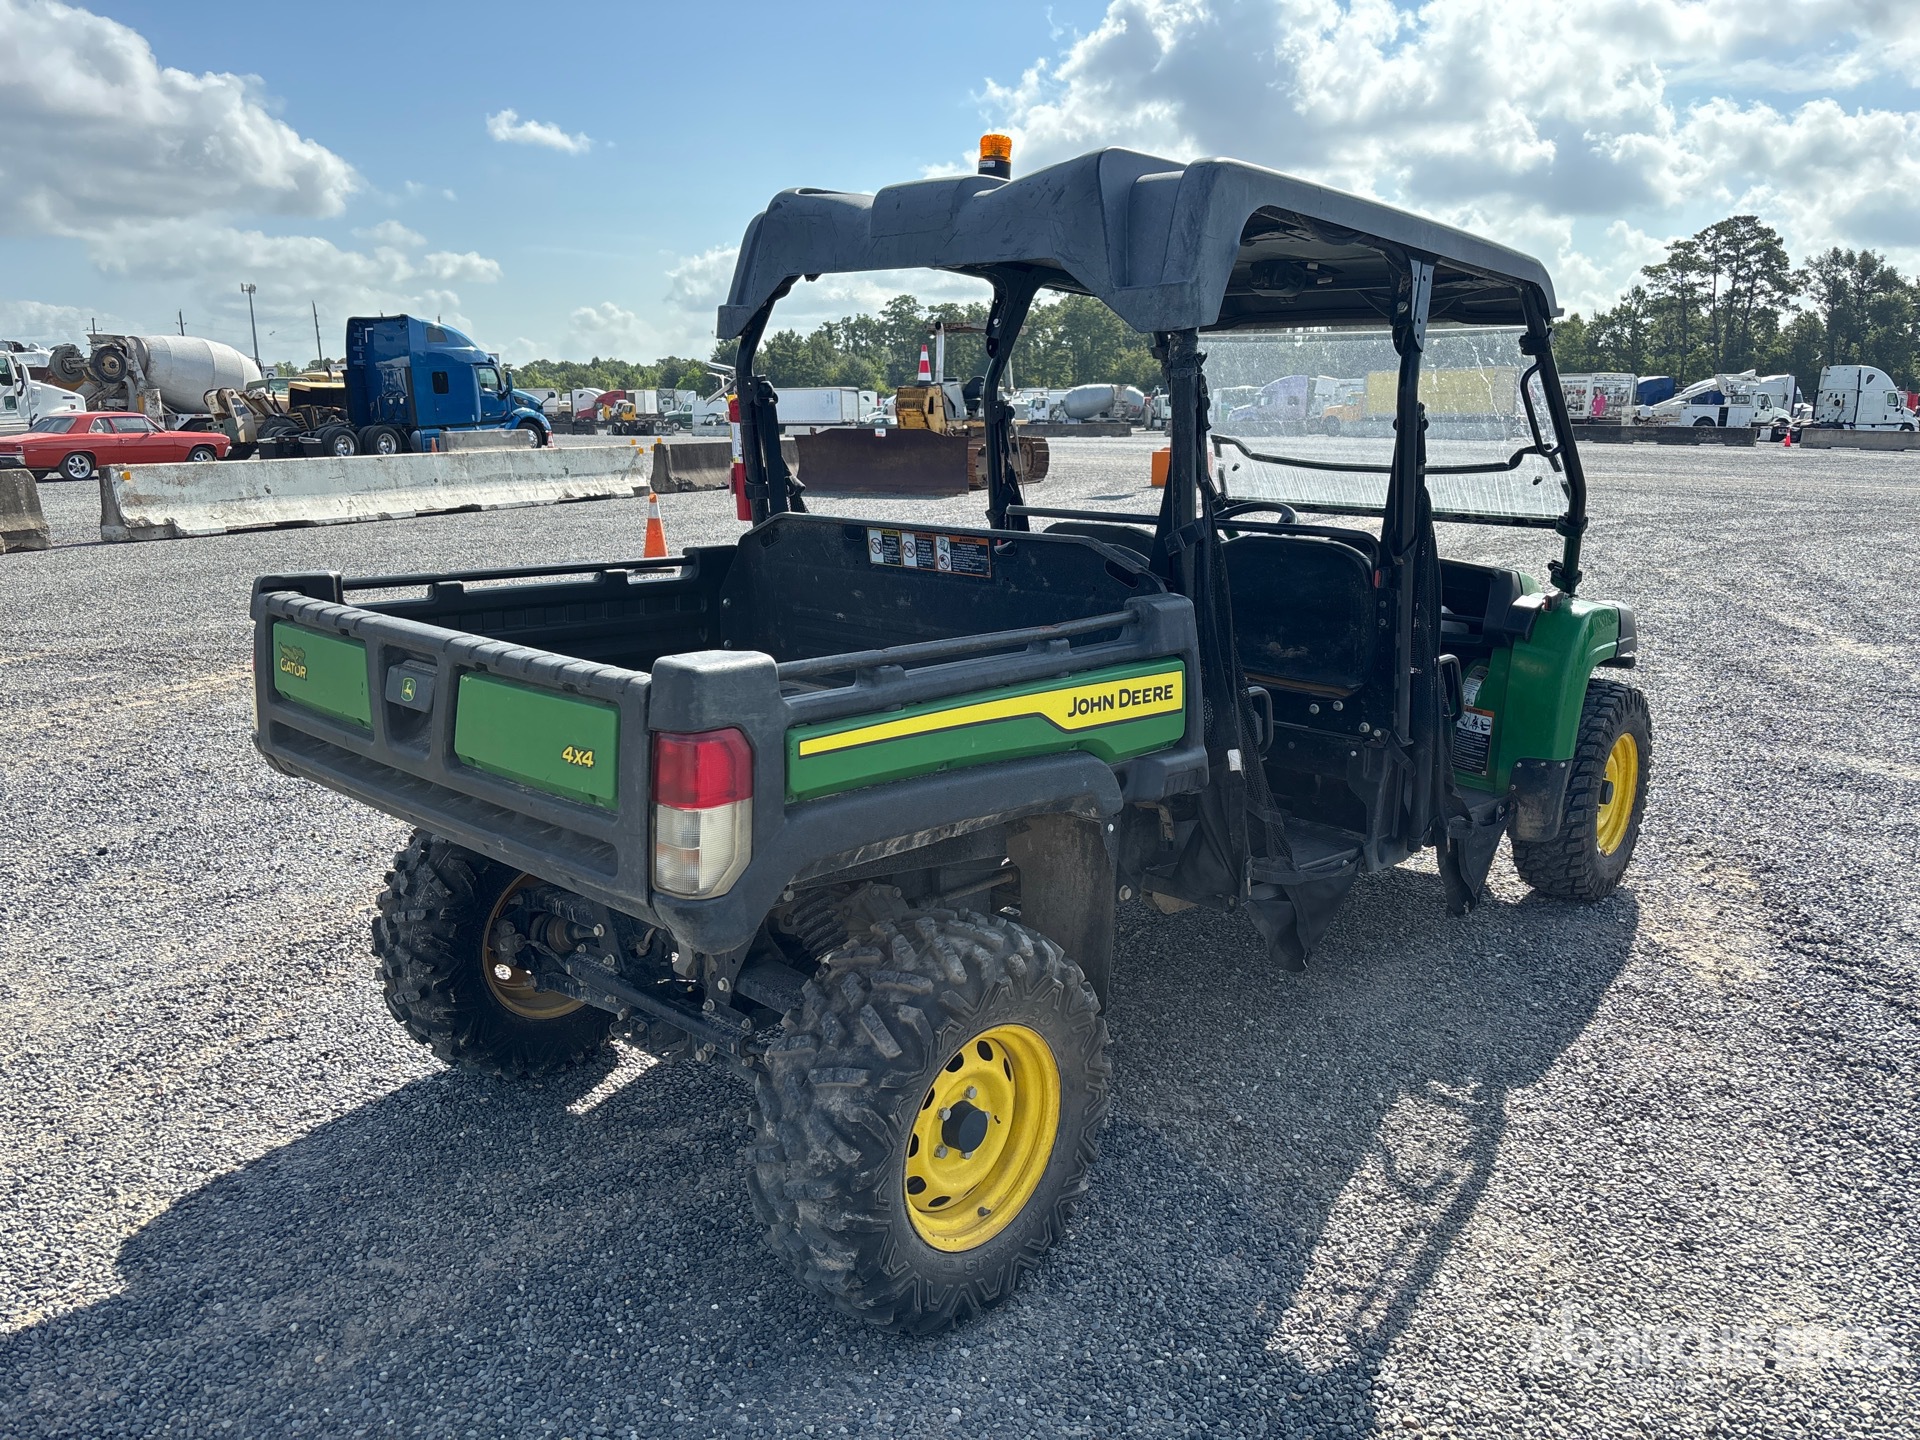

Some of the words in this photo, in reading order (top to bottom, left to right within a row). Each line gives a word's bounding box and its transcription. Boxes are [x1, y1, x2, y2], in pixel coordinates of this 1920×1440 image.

[280, 657, 307, 680] GATOR
[1067, 694, 1115, 718] JOHN
[1118, 683, 1174, 709] DEERE
